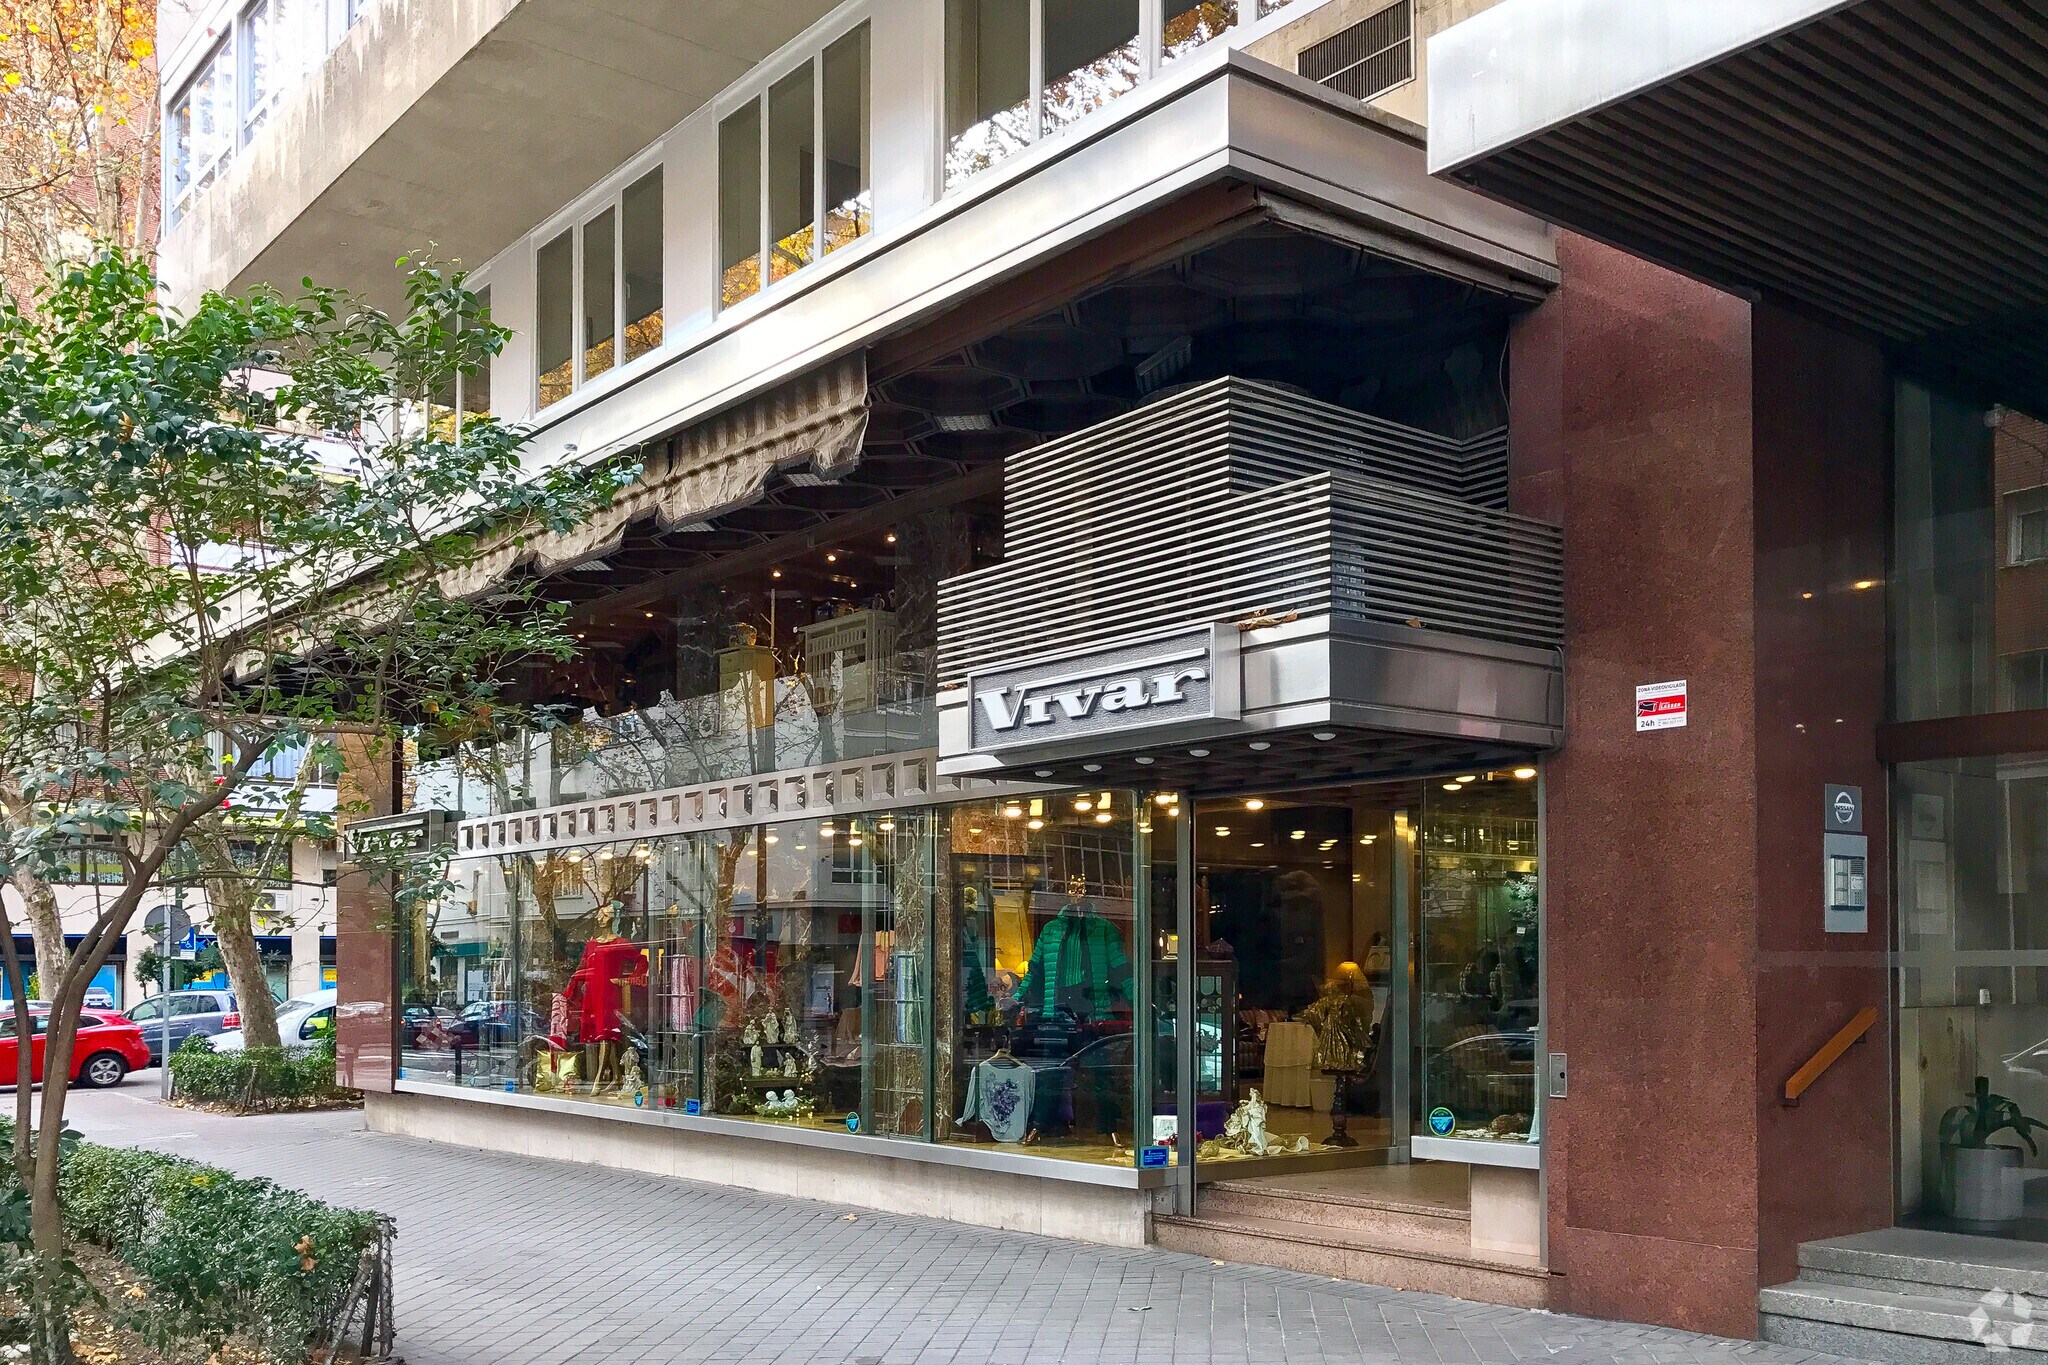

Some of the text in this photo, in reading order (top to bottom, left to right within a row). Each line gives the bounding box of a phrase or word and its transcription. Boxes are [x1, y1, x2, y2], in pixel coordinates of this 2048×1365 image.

[1651, 682, 1685, 691] VIDEOVIGILADA
[974, 664, 1206, 731] Vivar
[1641, 720, 1655, 728] 24h
[1835, 804, 1853, 812] NISSAN
